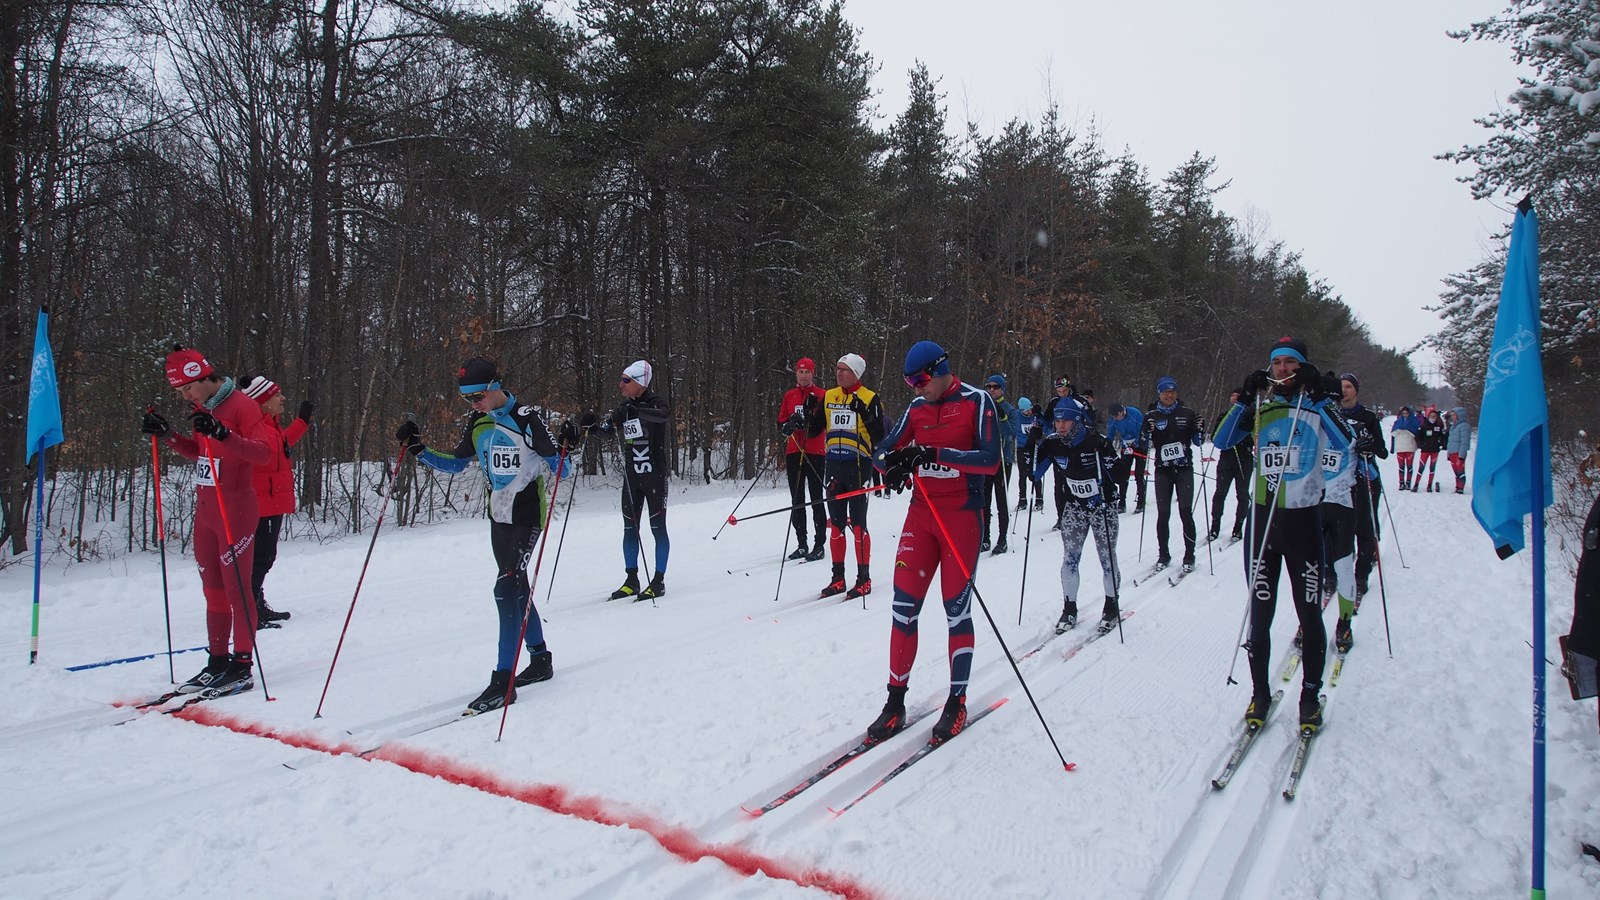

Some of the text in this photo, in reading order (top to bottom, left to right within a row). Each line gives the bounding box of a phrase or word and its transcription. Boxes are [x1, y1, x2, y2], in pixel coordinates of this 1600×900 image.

[834, 414, 851, 425] 067
[1163, 446, 1180, 457] 058
[493, 452, 521, 469] 054
[1264, 452, 1290, 468] 051
[1321, 454, 1337, 467] 55
[1071, 484, 1092, 494] 060
[220, 536, 248, 560] Foneurs
[222, 533, 255, 567] Larentides
